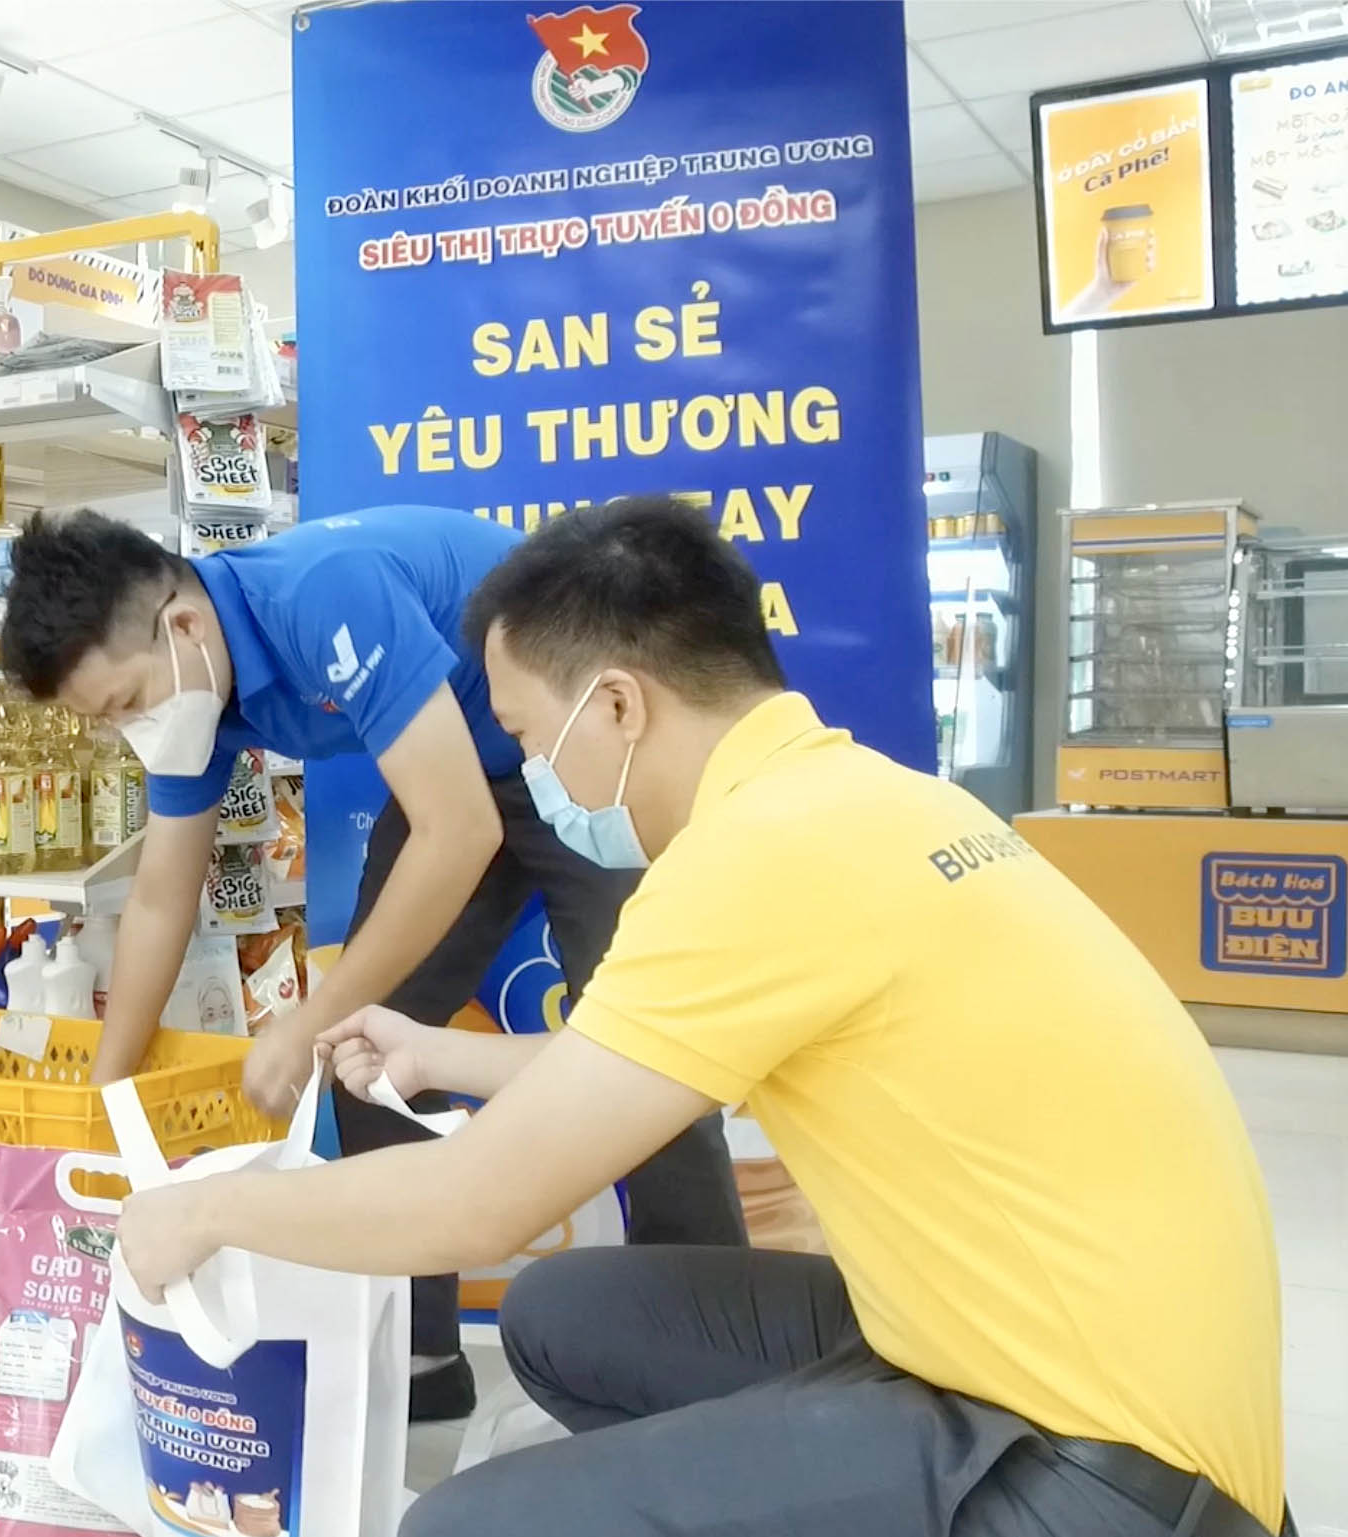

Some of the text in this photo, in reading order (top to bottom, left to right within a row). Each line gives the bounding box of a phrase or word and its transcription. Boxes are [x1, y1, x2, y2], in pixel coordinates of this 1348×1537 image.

[326, 135, 874, 217] ĐOÀN KHỐI DOANH NGHIỆP TRUNG ƯƠNG
[359, 230, 433, 271] SIÊU
[438, 229, 493, 266] THỊ
[500, 216, 588, 259] TRỰC
[592, 189, 704, 245] TUYẾN
[736, 186, 837, 229] ĐỒNG
[472, 281, 723, 377] SAN SẺ
[369, 386, 841, 475] YÊU THƯƠNG
[211, 456, 247, 472] BIG
[1098, 769, 1221, 783] POSTMART
[226, 784, 257, 806] BIG
[222, 875, 253, 895] BIG
[1219, 871, 1277, 889] Bách
[1225, 933, 1319, 964] ĐIỆN
[23, 1279, 83, 1304] SÔNG
[162, 1381, 200, 1398] TRUNG
[202, 1407, 258, 1435] ĐỒNG
[144, 1412, 205, 1445] TRUNG
[206, 1432, 270, 1458] ƯƠNG
